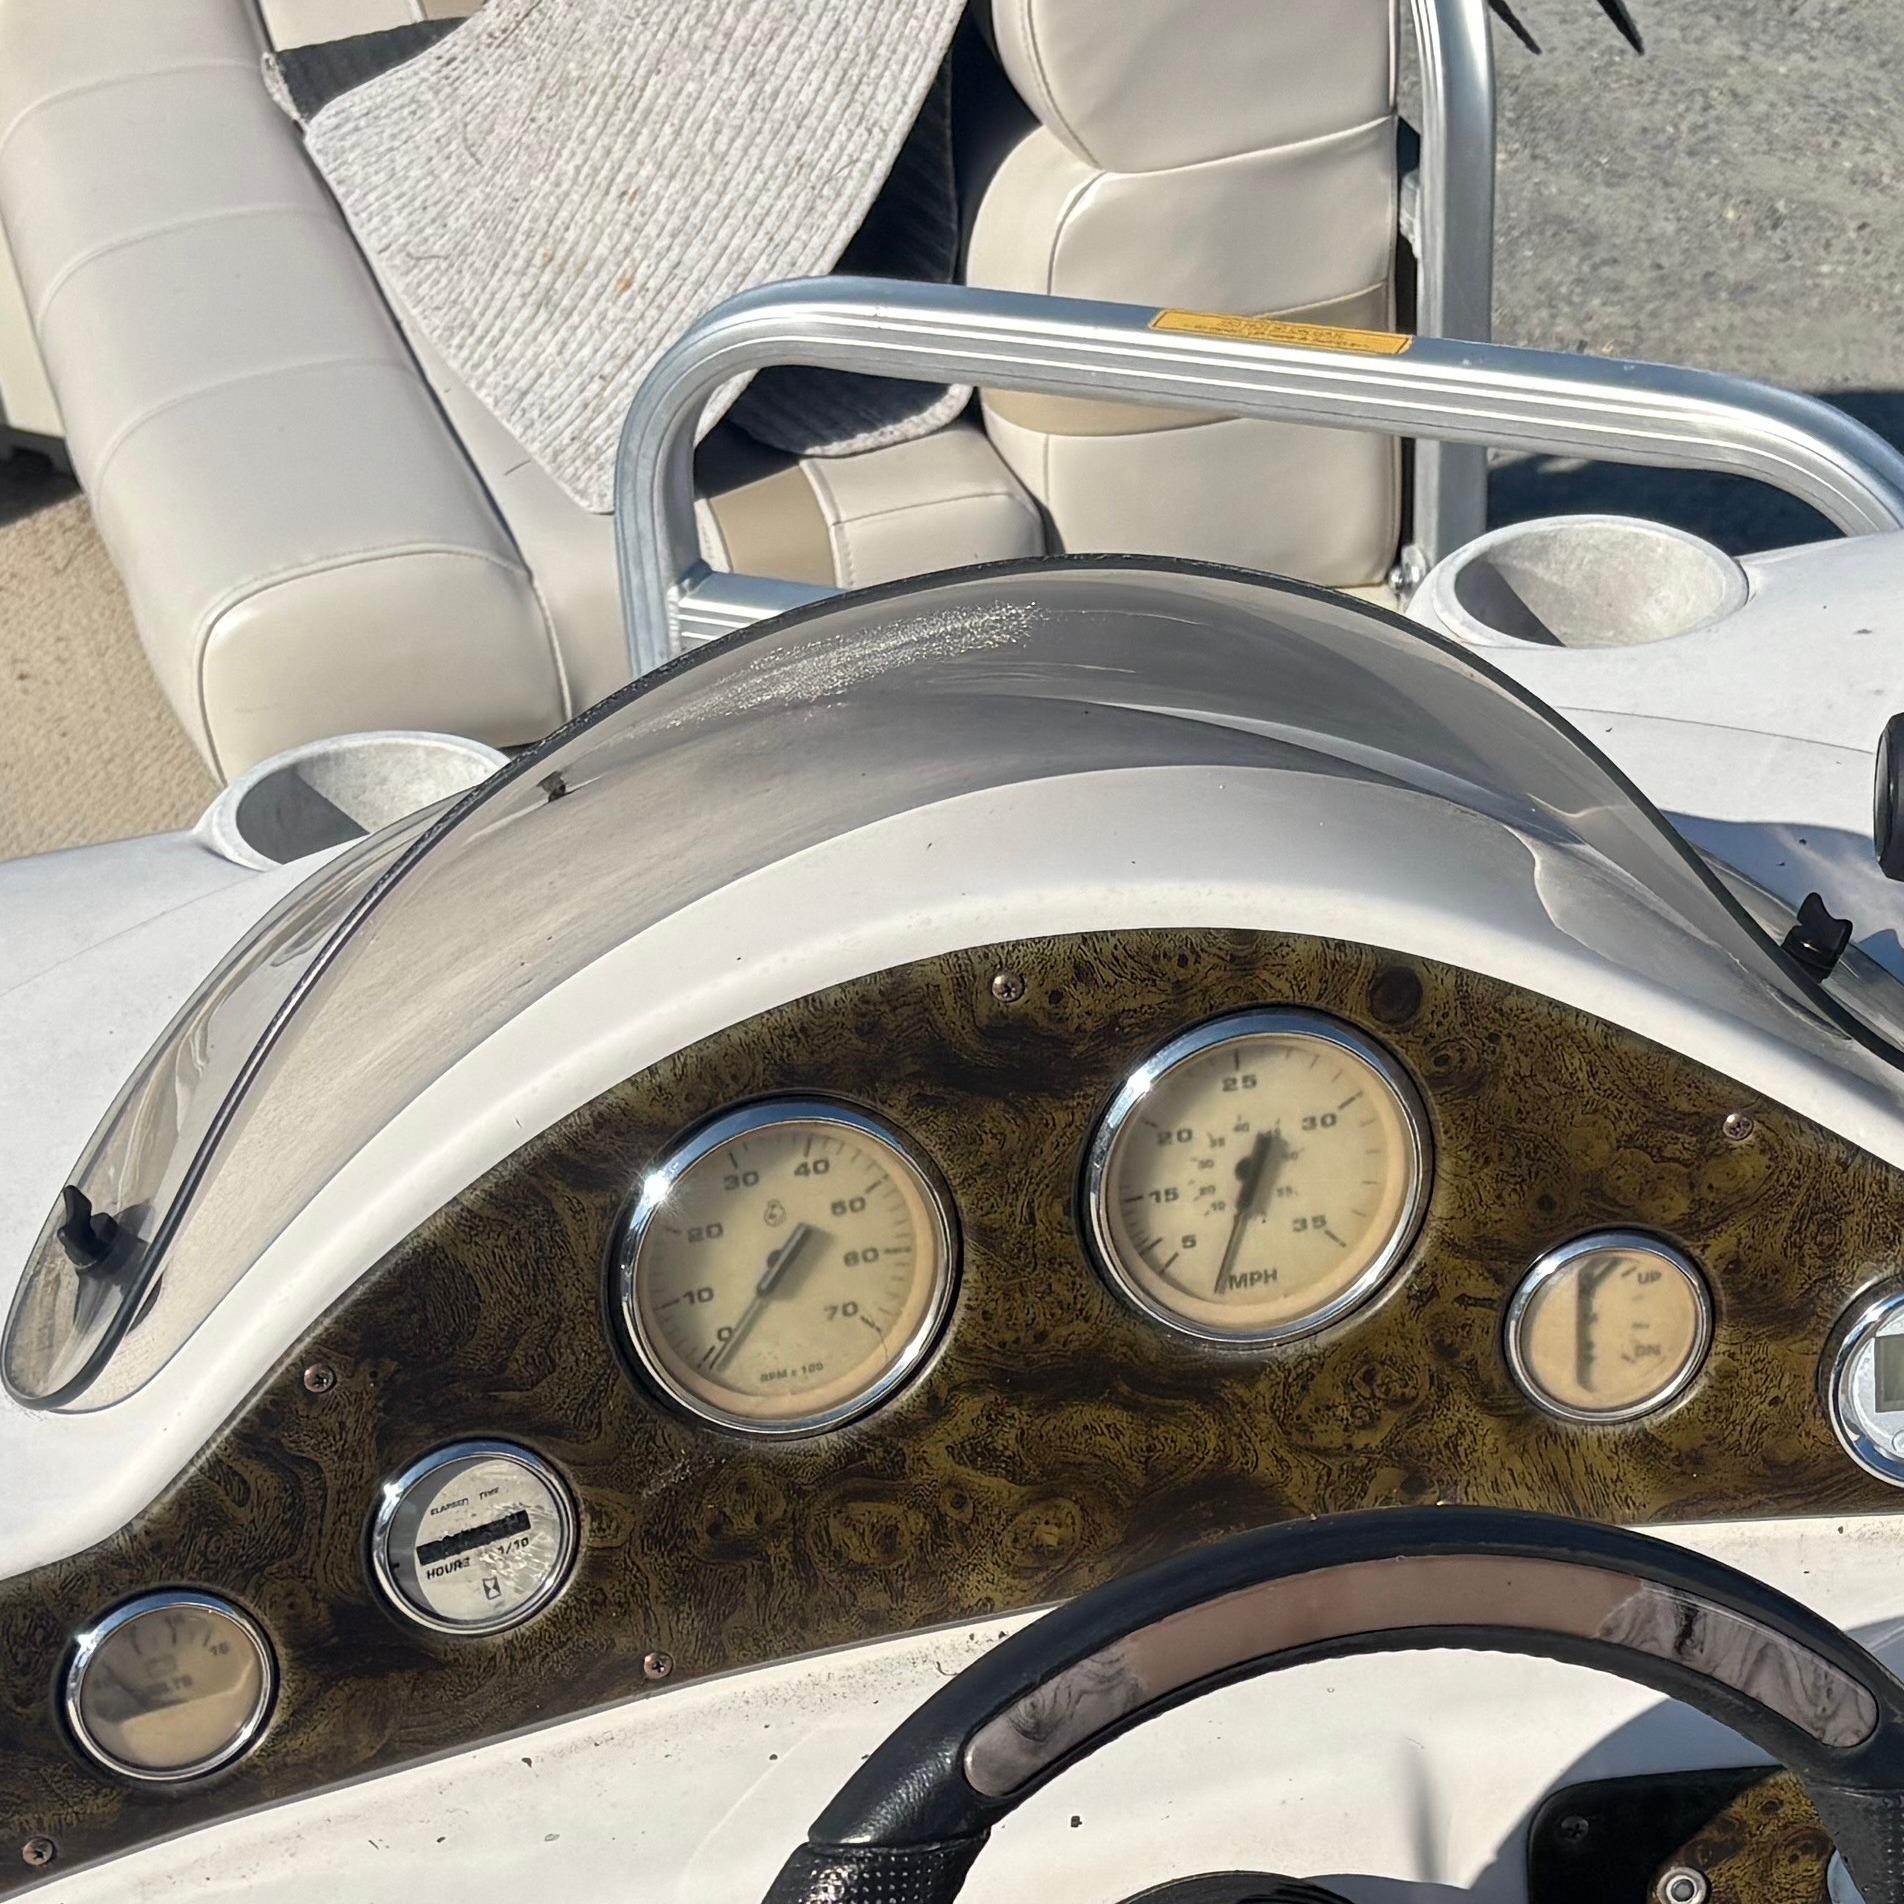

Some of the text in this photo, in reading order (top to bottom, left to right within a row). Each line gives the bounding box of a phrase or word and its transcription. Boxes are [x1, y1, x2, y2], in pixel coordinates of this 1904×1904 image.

[1221, 1075, 1257, 1092] 25
[1301, 1113, 1337, 1131] 30
[1156, 1129, 1193, 1146] 20
[794, 1159, 830, 1177] 40
[723, 1172, 759, 1191] 30
[1149, 1188, 1179, 1204] 15
[831, 1197, 866, 1216] 50
[1292, 1215, 1327, 1232] 35
[687, 1223, 723, 1243] 20
[1181, 1235, 1197, 1249] 5
[843, 1248, 879, 1267] 60
[1228, 1268, 1278, 1290] MPH
[1637, 1271, 1662, 1285] UP
[683, 1287, 714, 1304] 10
[823, 1302, 858, 1321] 70
[717, 1326, 734, 1342] 0
[760, 1368, 788, 1384] RPM
[799, 1362, 824, 1376] 100
[426, 1537, 530, 1580] HOURS 1/10
